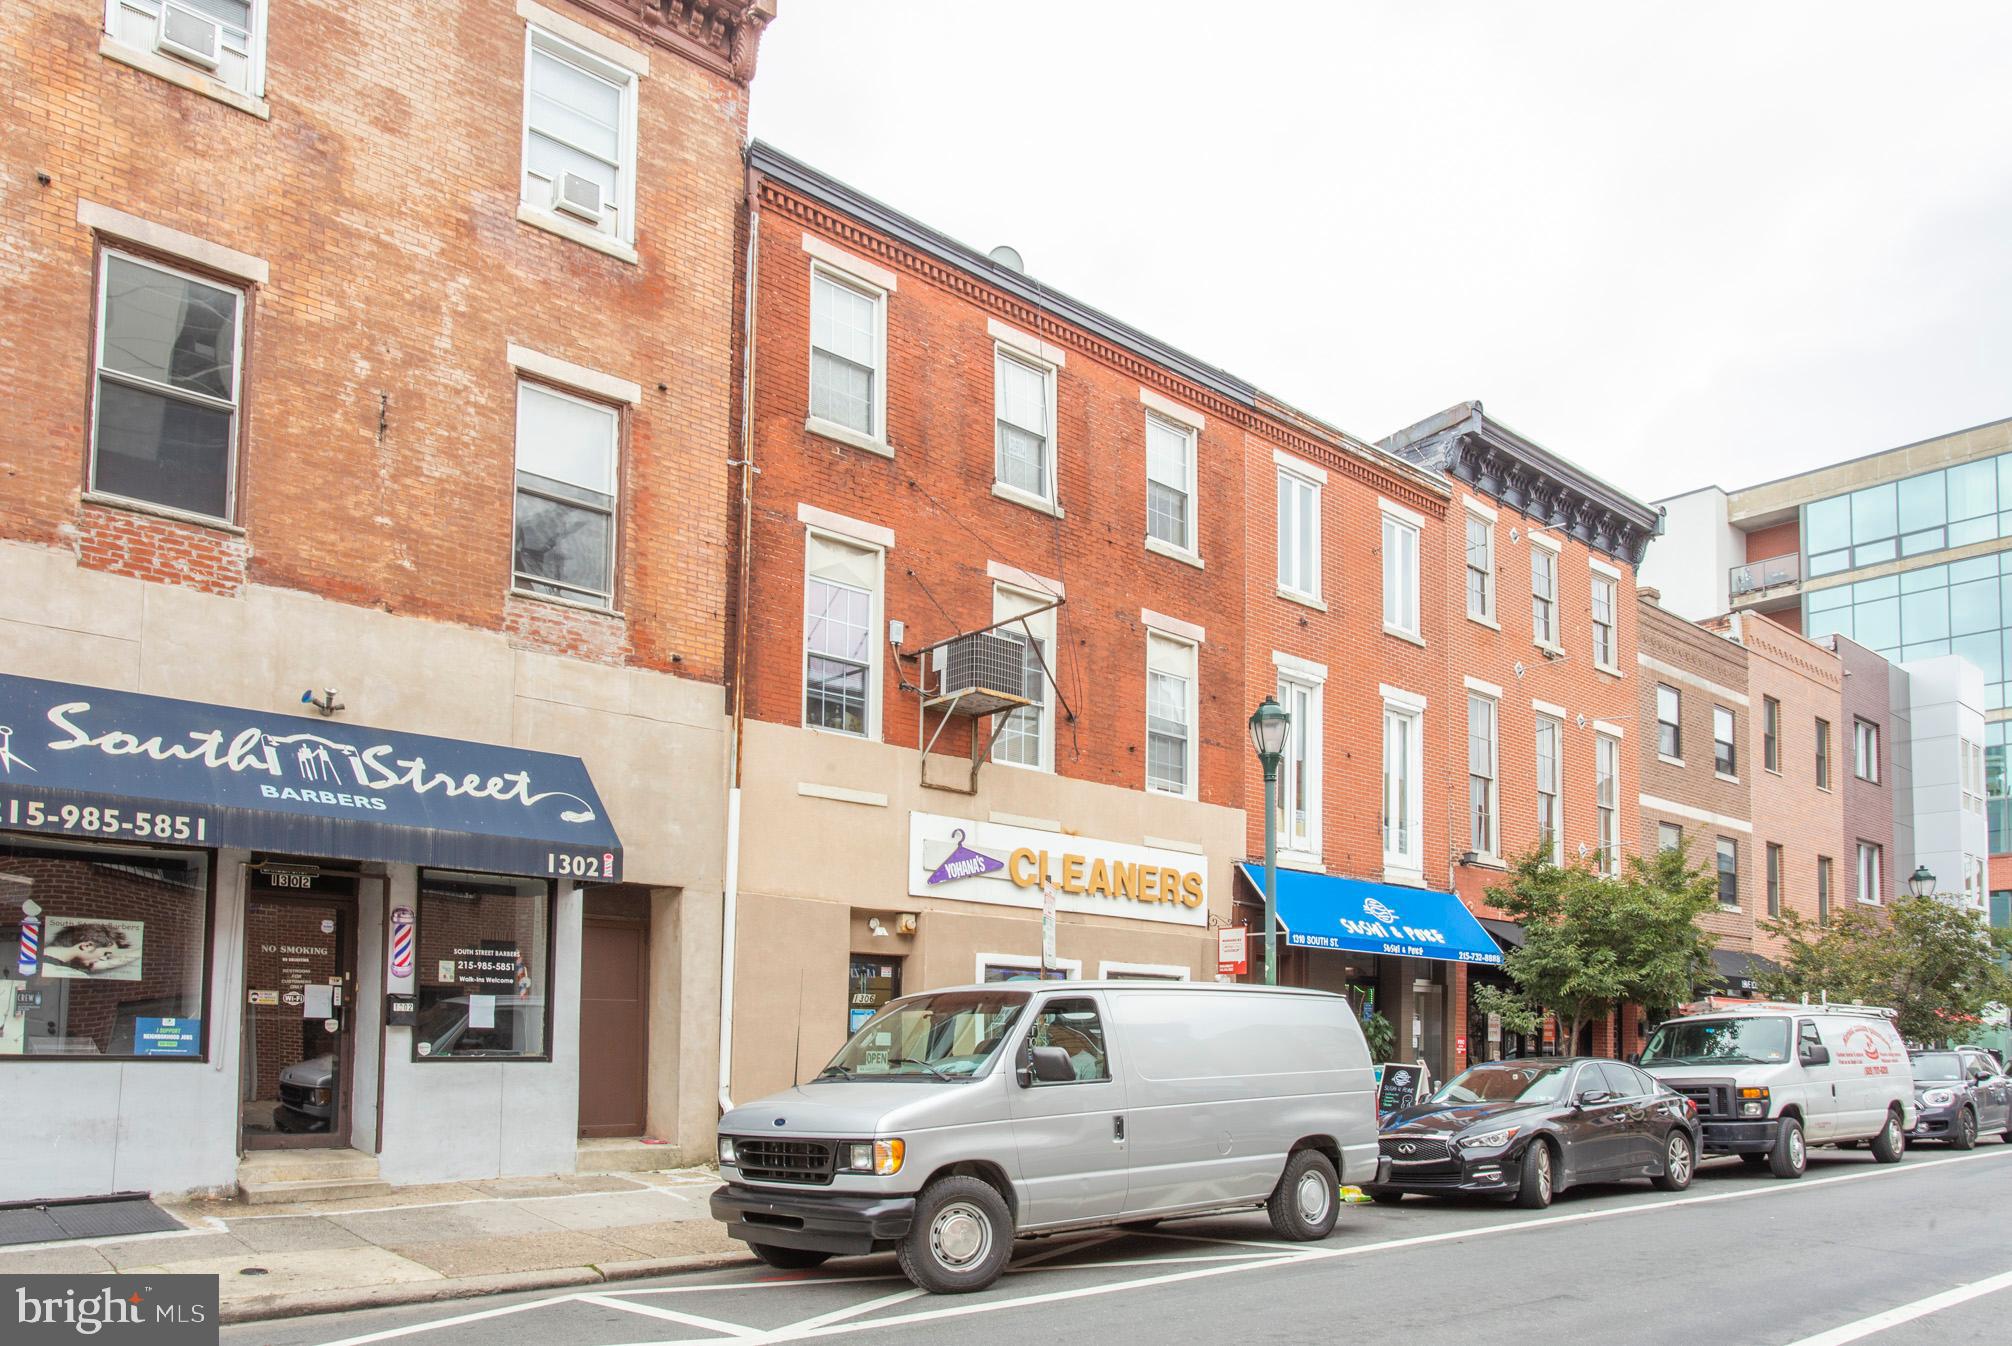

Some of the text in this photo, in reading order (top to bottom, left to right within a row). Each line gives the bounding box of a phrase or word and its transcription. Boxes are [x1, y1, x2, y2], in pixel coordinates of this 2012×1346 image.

[47, 702, 562, 808] South Street
[260, 784, 388, 811] BARBERS
[0, 799, 206, 841] 15-985-5851
[548, 853, 599, 877] 1302
[944, 854, 986, 880] YOHANA'S
[272, 874, 310, 888] 1302
[1009, 847, 1204, 908] CLEANERS
[1306, 935, 1329, 947] SOUTH
[261, 944, 328, 955] NO SMOKING
[453, 948, 521, 958] SOUTH STREET BARBERS
[458, 960, 515, 971] 215-985-5851
[853, 993, 876, 1003] 1306
[866, 1052, 887, 1065] OPEN
